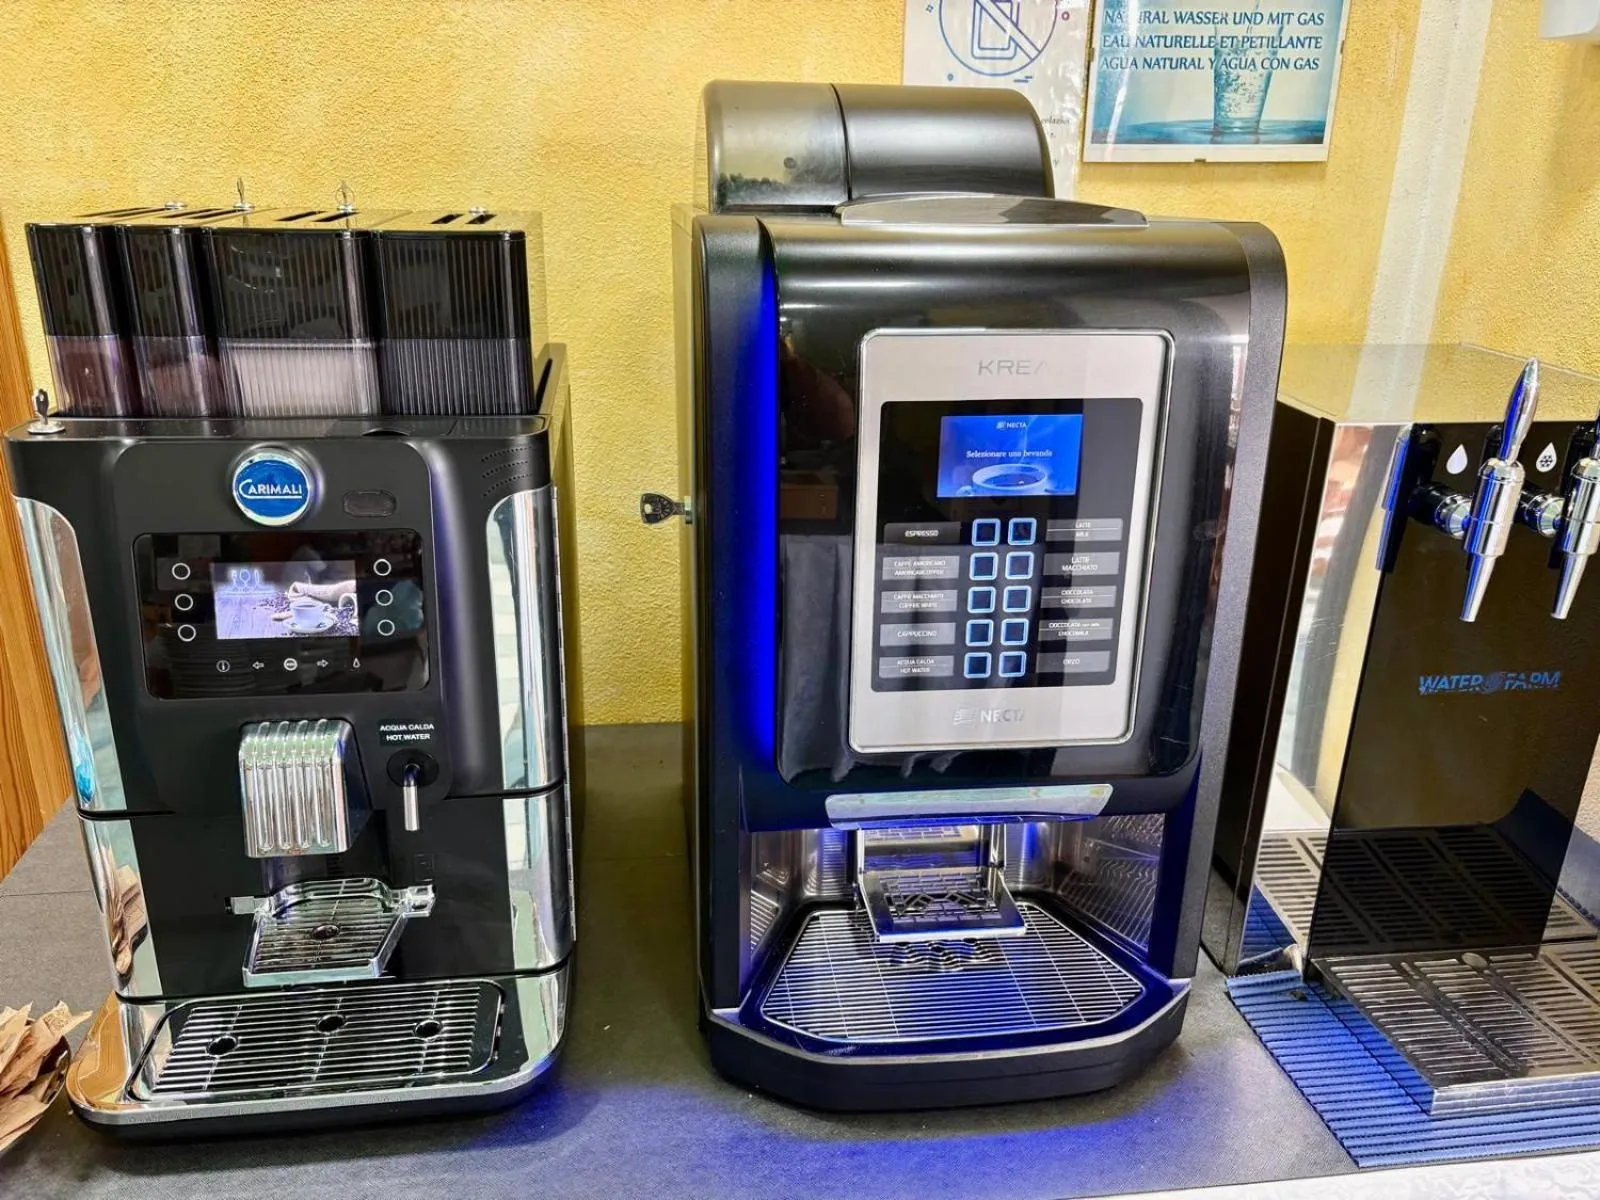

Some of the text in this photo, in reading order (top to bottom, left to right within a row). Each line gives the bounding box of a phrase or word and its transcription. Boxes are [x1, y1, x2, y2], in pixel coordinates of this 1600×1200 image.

[1104, 10, 1325, 26] NARAL WASSER UND MIT GAS
[1103, 35, 1322, 49] EAU NATURELLE ET PETILLANTE
[1101, 57, 1320, 70] AGUA NATURAL Y AGUA CON GAS
[1006, 421, 1027, 429] NECTA
[966, 450, 1007, 458] Selezionare
[238, 478, 302, 499] CARIMALI
[904, 529, 939, 538] ESPRESSO
[897, 630, 937, 638] CAPPUCCINO
[1419, 674, 1484, 692] WATER
